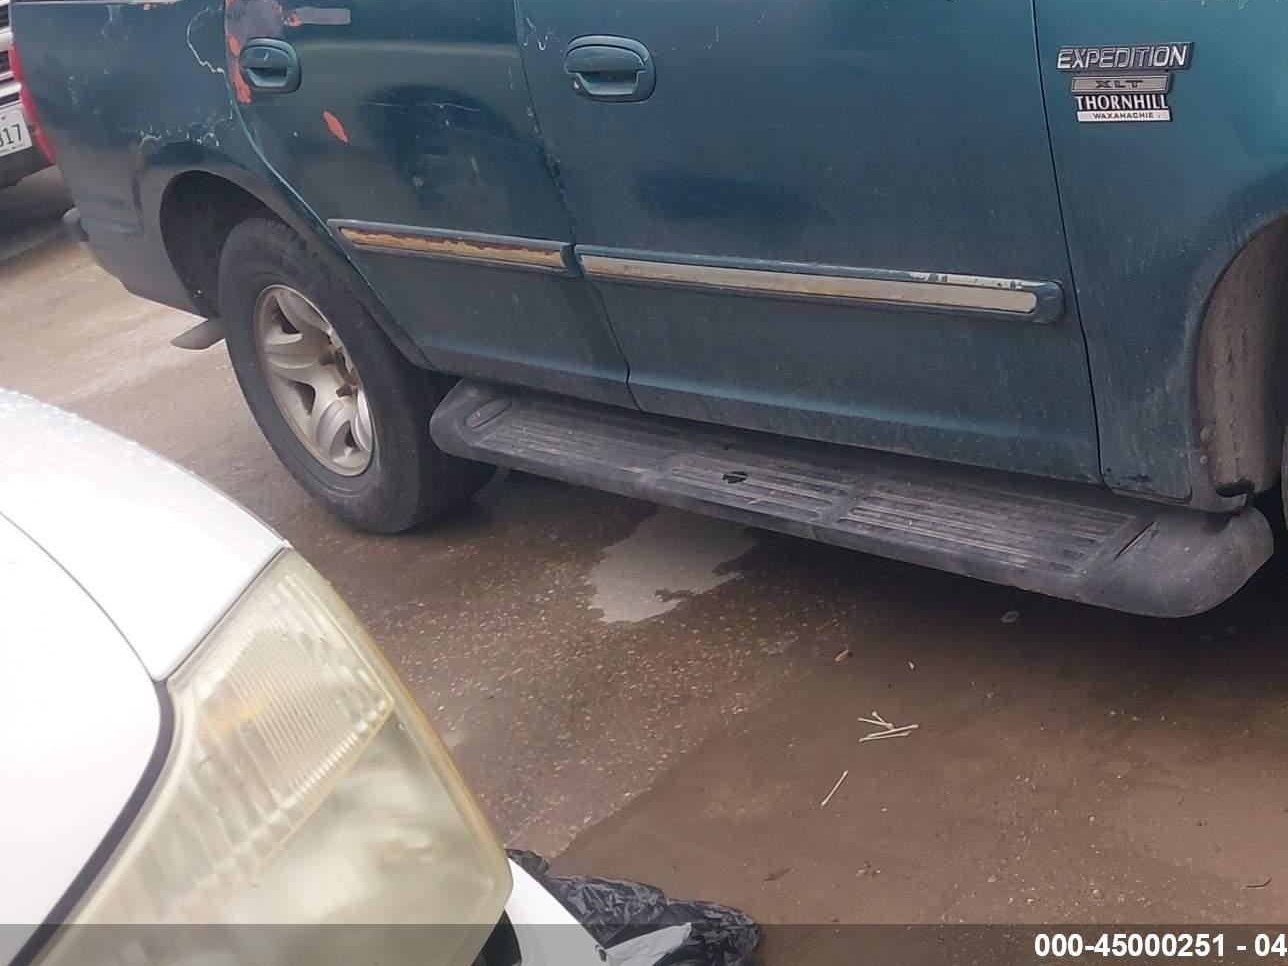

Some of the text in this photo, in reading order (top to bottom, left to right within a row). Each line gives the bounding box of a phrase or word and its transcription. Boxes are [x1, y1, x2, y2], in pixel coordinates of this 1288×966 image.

[1057, 46, 1187, 69] EXPEDITION
[1094, 79, 1144, 89] XLT
[1074, 94, 1169, 111] THORNHILL
[1092, 112, 1154, 120] WAXAHACHIE
